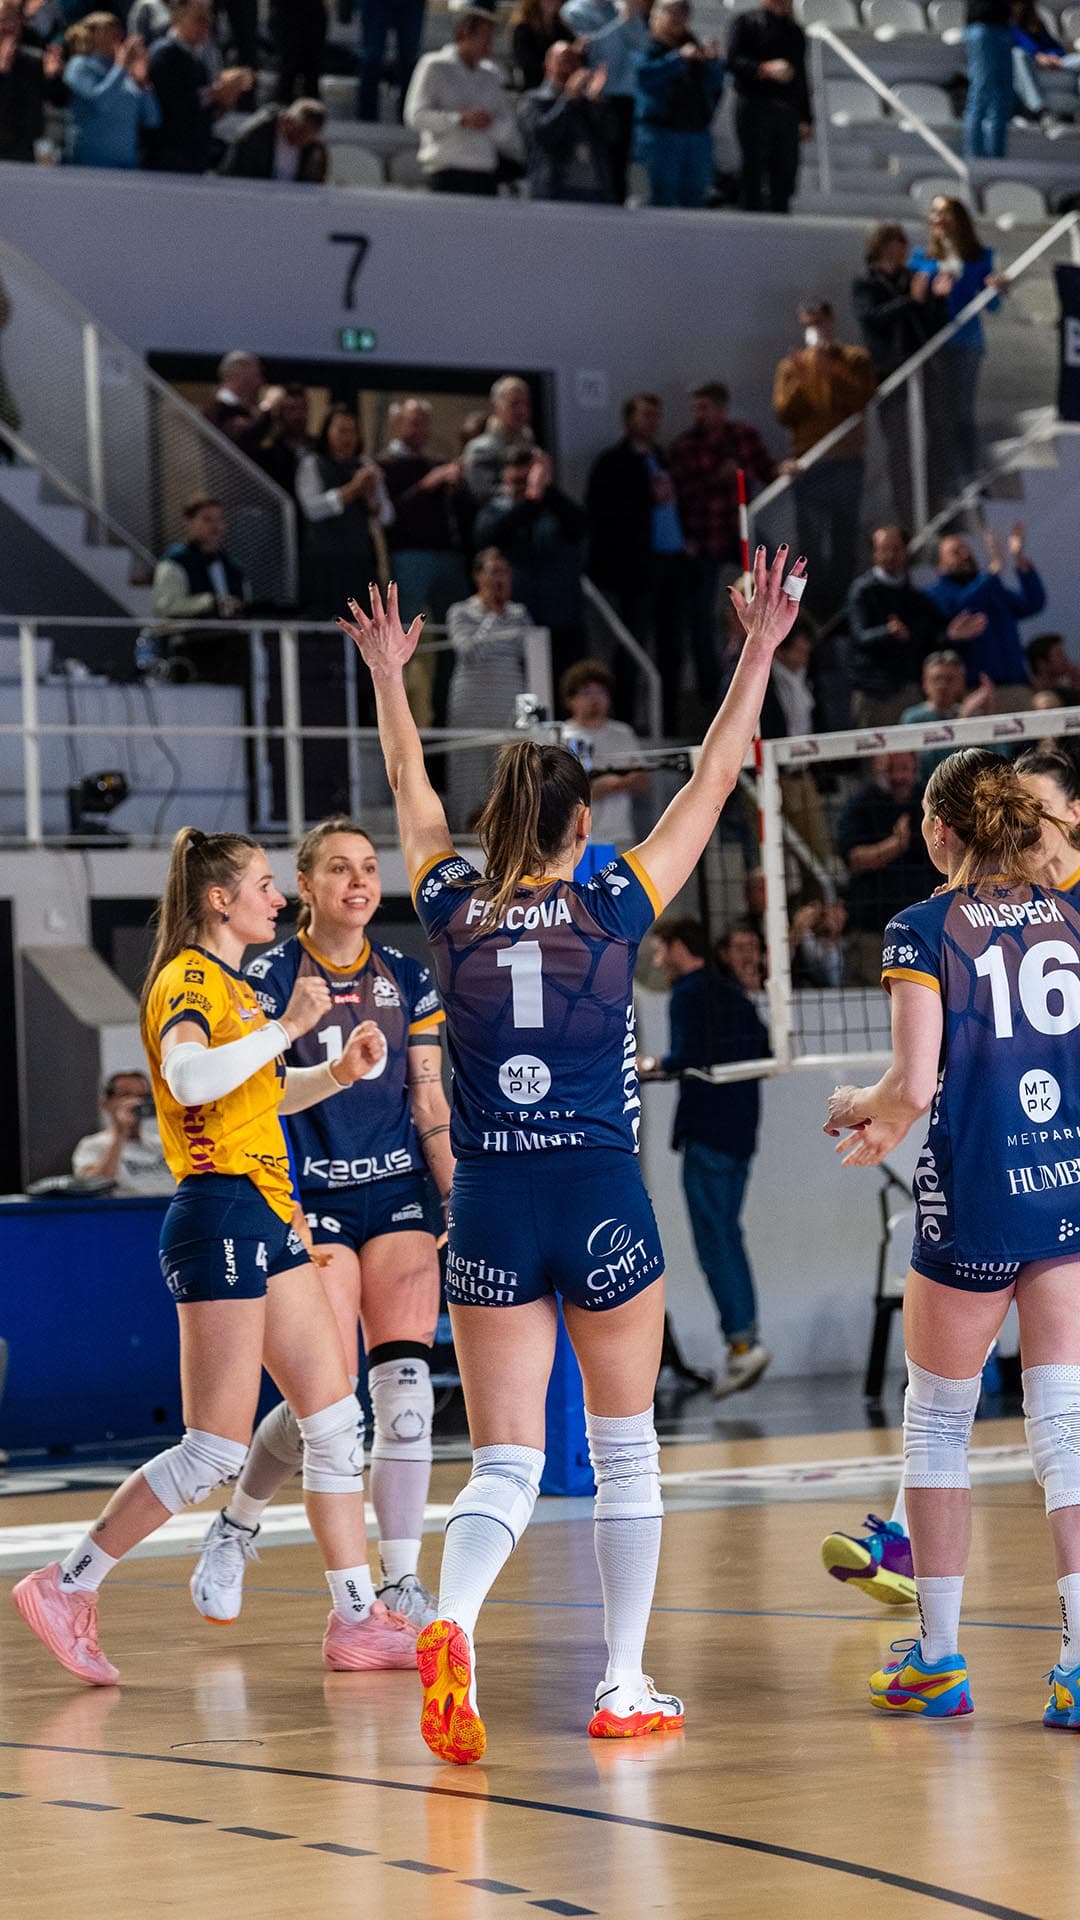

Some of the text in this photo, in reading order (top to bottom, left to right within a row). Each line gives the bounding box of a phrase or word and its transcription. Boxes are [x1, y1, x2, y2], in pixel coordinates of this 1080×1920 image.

[328, 232, 370, 310] 7
[960, 898, 1065, 928] WALSPECK
[496, 940, 545, 1029] 1
[973, 939, 1080, 1039] 16
[508, 1066, 541, 1079] MT
[510, 1081, 541, 1094] PK
[1024, 1080, 1050, 1096] MT
[481, 1110, 577, 1123] ETPARK
[1027, 1097, 1052, 1113] PK
[1006, 1158, 1080, 1196] HUMB
[223, 1238, 237, 1275] CRAFT
[586, 1238, 648, 1291] CMFT
[585, 1255, 660, 1307] INDUSTRIE
[72, 1554, 93, 1578] CRAFT
[345, 1579, 362, 1602] CRAFT
[1059, 1595, 1069, 1632] CRAFT
